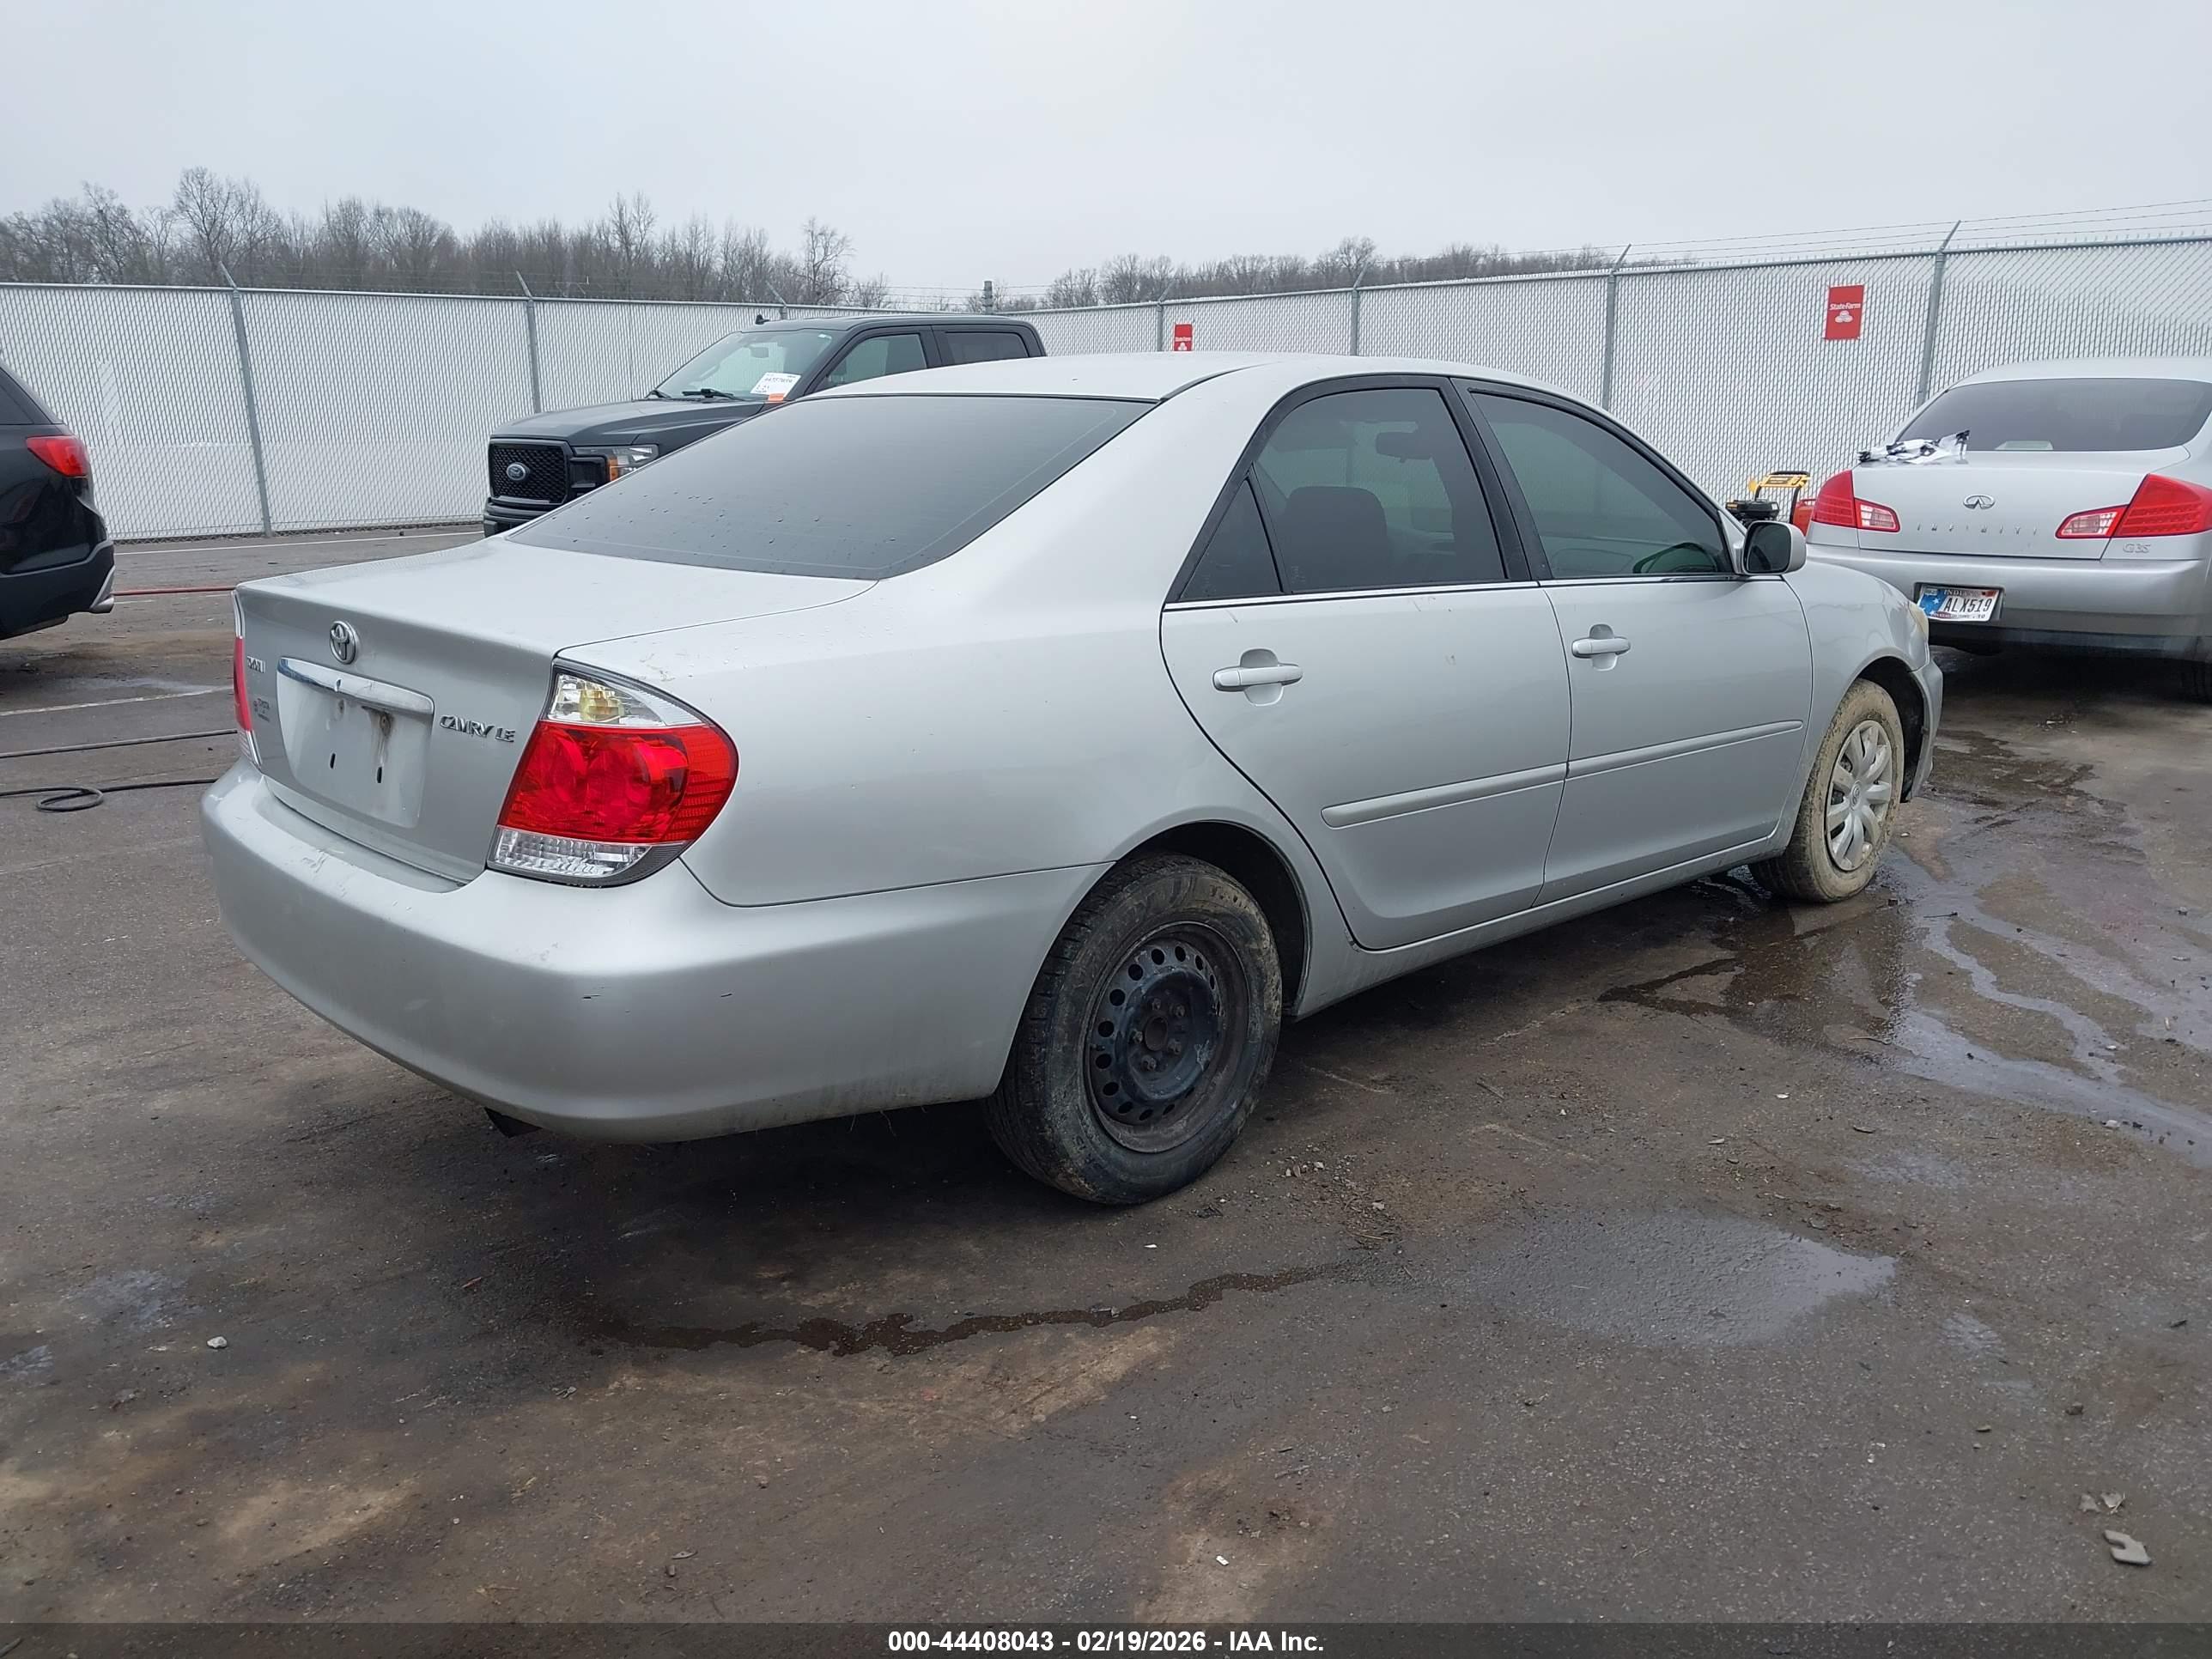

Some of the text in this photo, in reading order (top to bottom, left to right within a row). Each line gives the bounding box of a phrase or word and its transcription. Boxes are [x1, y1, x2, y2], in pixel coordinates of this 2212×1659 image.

[1943, 597, 1994, 613] ALX519
[439, 714, 516, 743] CAMRY LE
